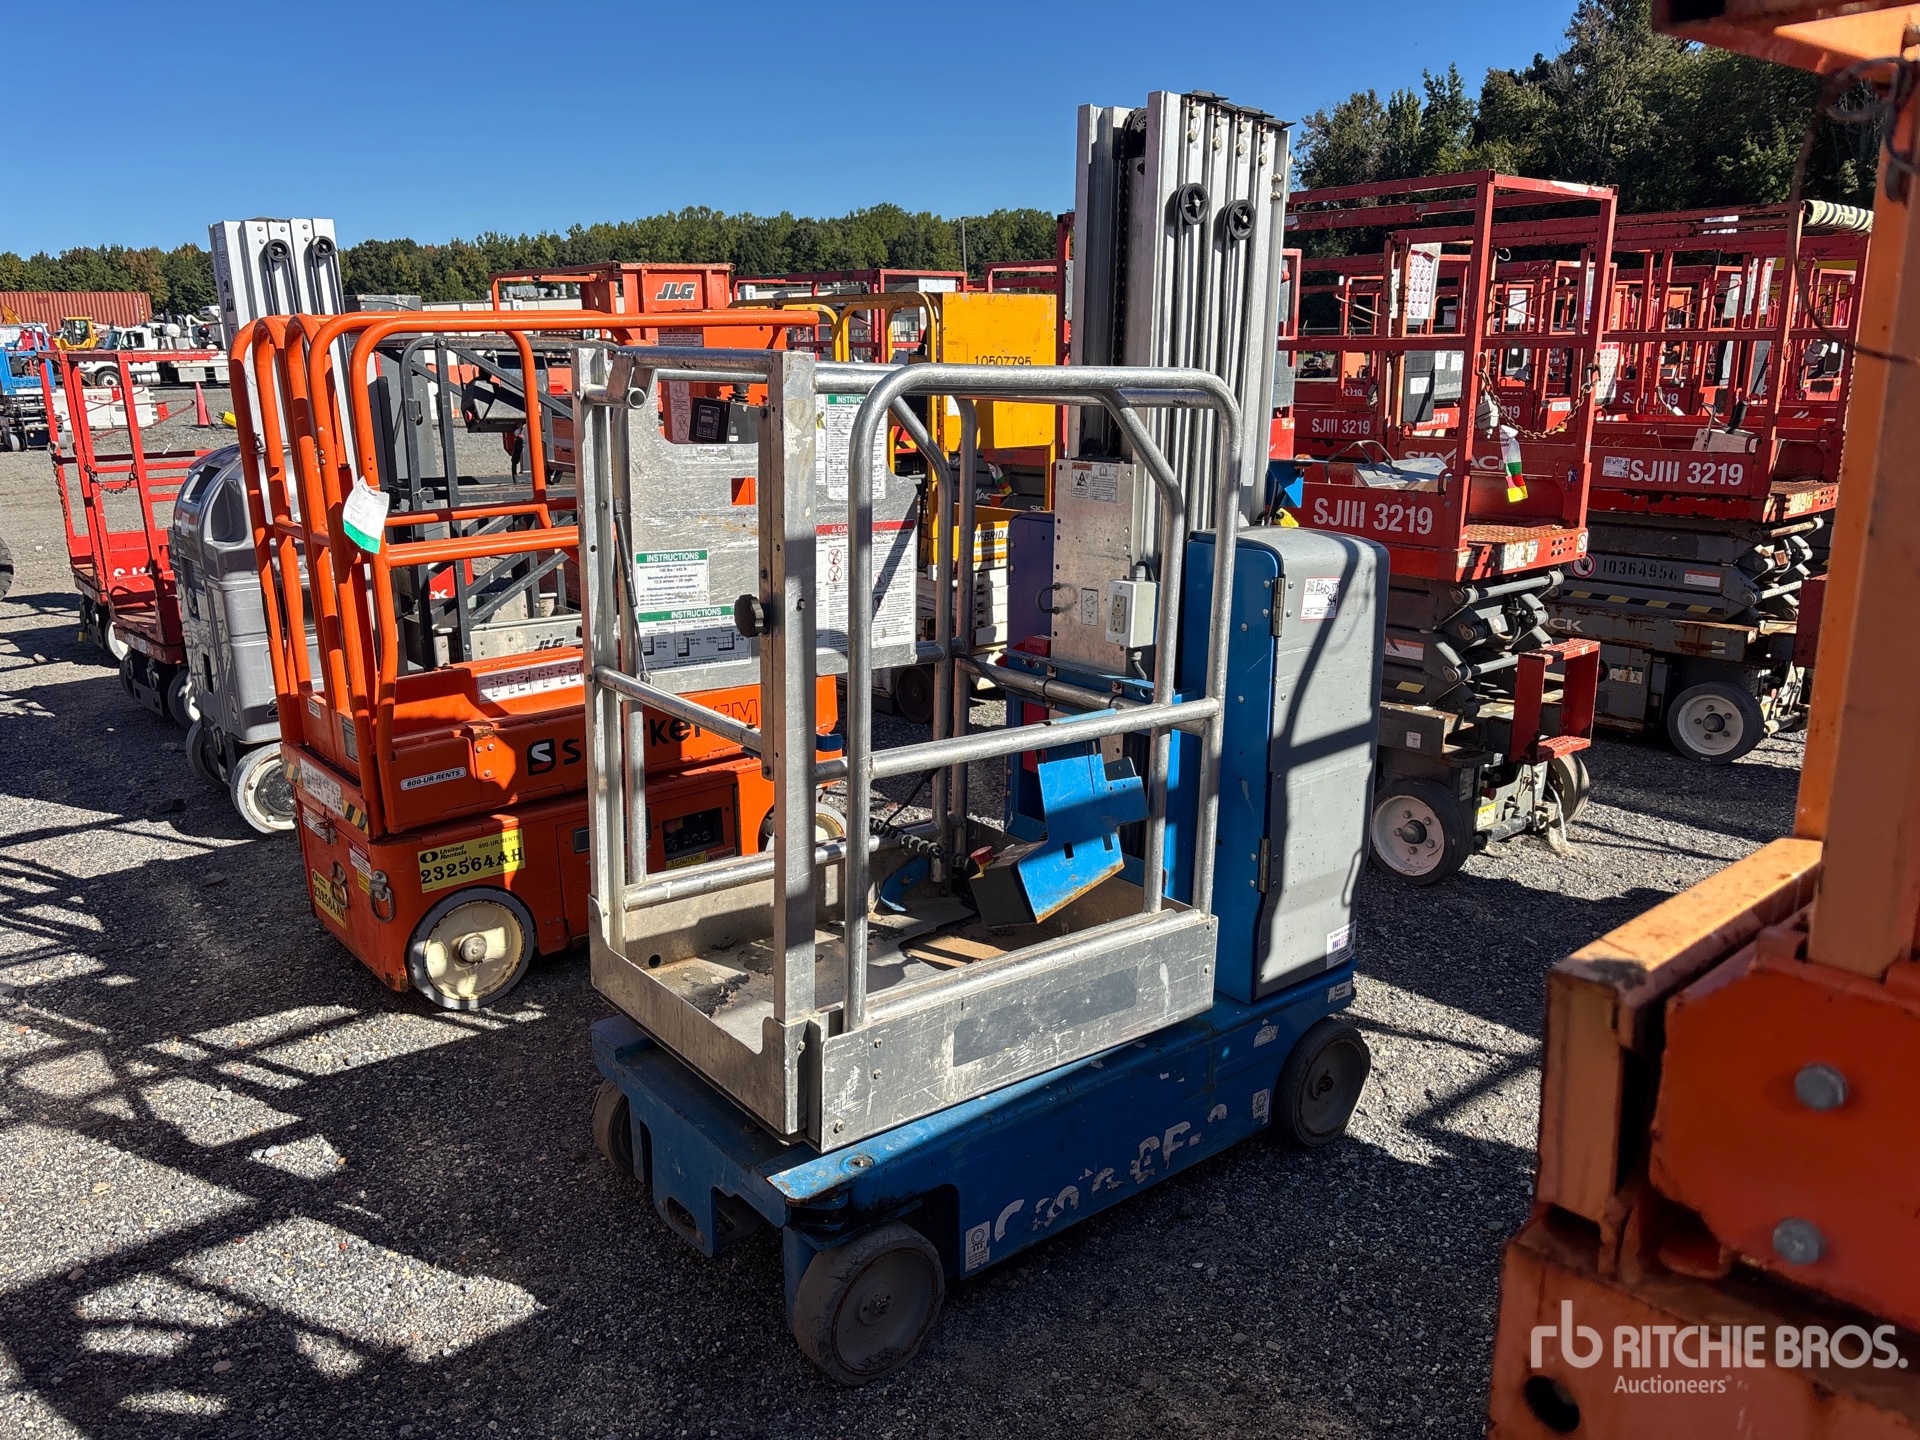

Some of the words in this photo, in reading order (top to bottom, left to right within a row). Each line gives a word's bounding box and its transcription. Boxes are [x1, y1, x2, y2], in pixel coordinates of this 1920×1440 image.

[655, 282, 697, 300] JLG
[975, 355, 1031, 366] 10507795
[1342, 419, 1370, 434] 3219
[1686, 462, 1744, 486] 3219
[1373, 502, 1433, 535] 3219
[975, 530, 1005, 542] Y-BRID
[646, 552, 699, 562] INSTRUCTIONS
[671, 608, 722, 619] INSTRUCTIONS
[407, 770, 460, 787] 800-UR-RENTS
[440, 844, 464, 854] United
[440, 850, 467, 860] Rentals
[420, 846, 524, 884] 232564AH
